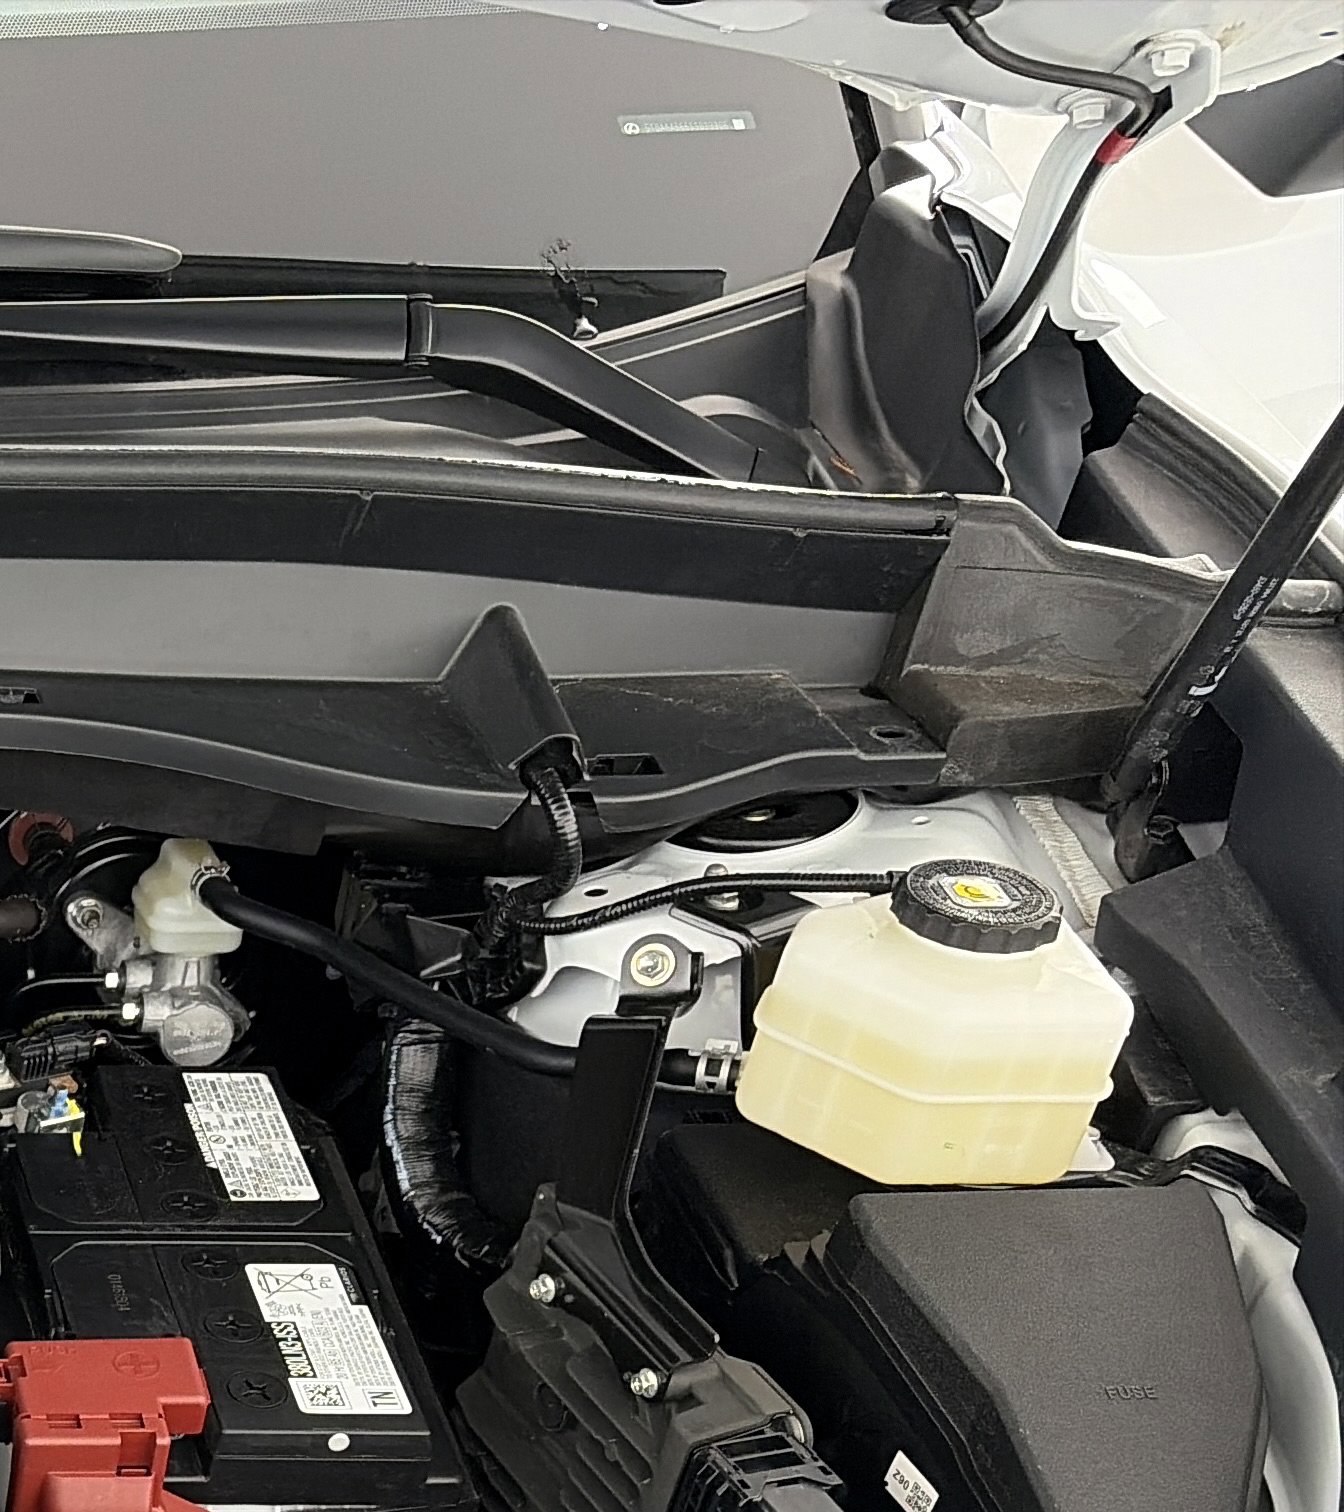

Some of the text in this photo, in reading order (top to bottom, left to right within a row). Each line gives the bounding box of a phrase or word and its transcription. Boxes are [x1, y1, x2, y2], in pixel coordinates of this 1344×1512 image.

[319, 1276, 335, 1289] Pb
[367, 1391, 399, 1407] TN
[1104, 1384, 1159, 1400] FUSE
